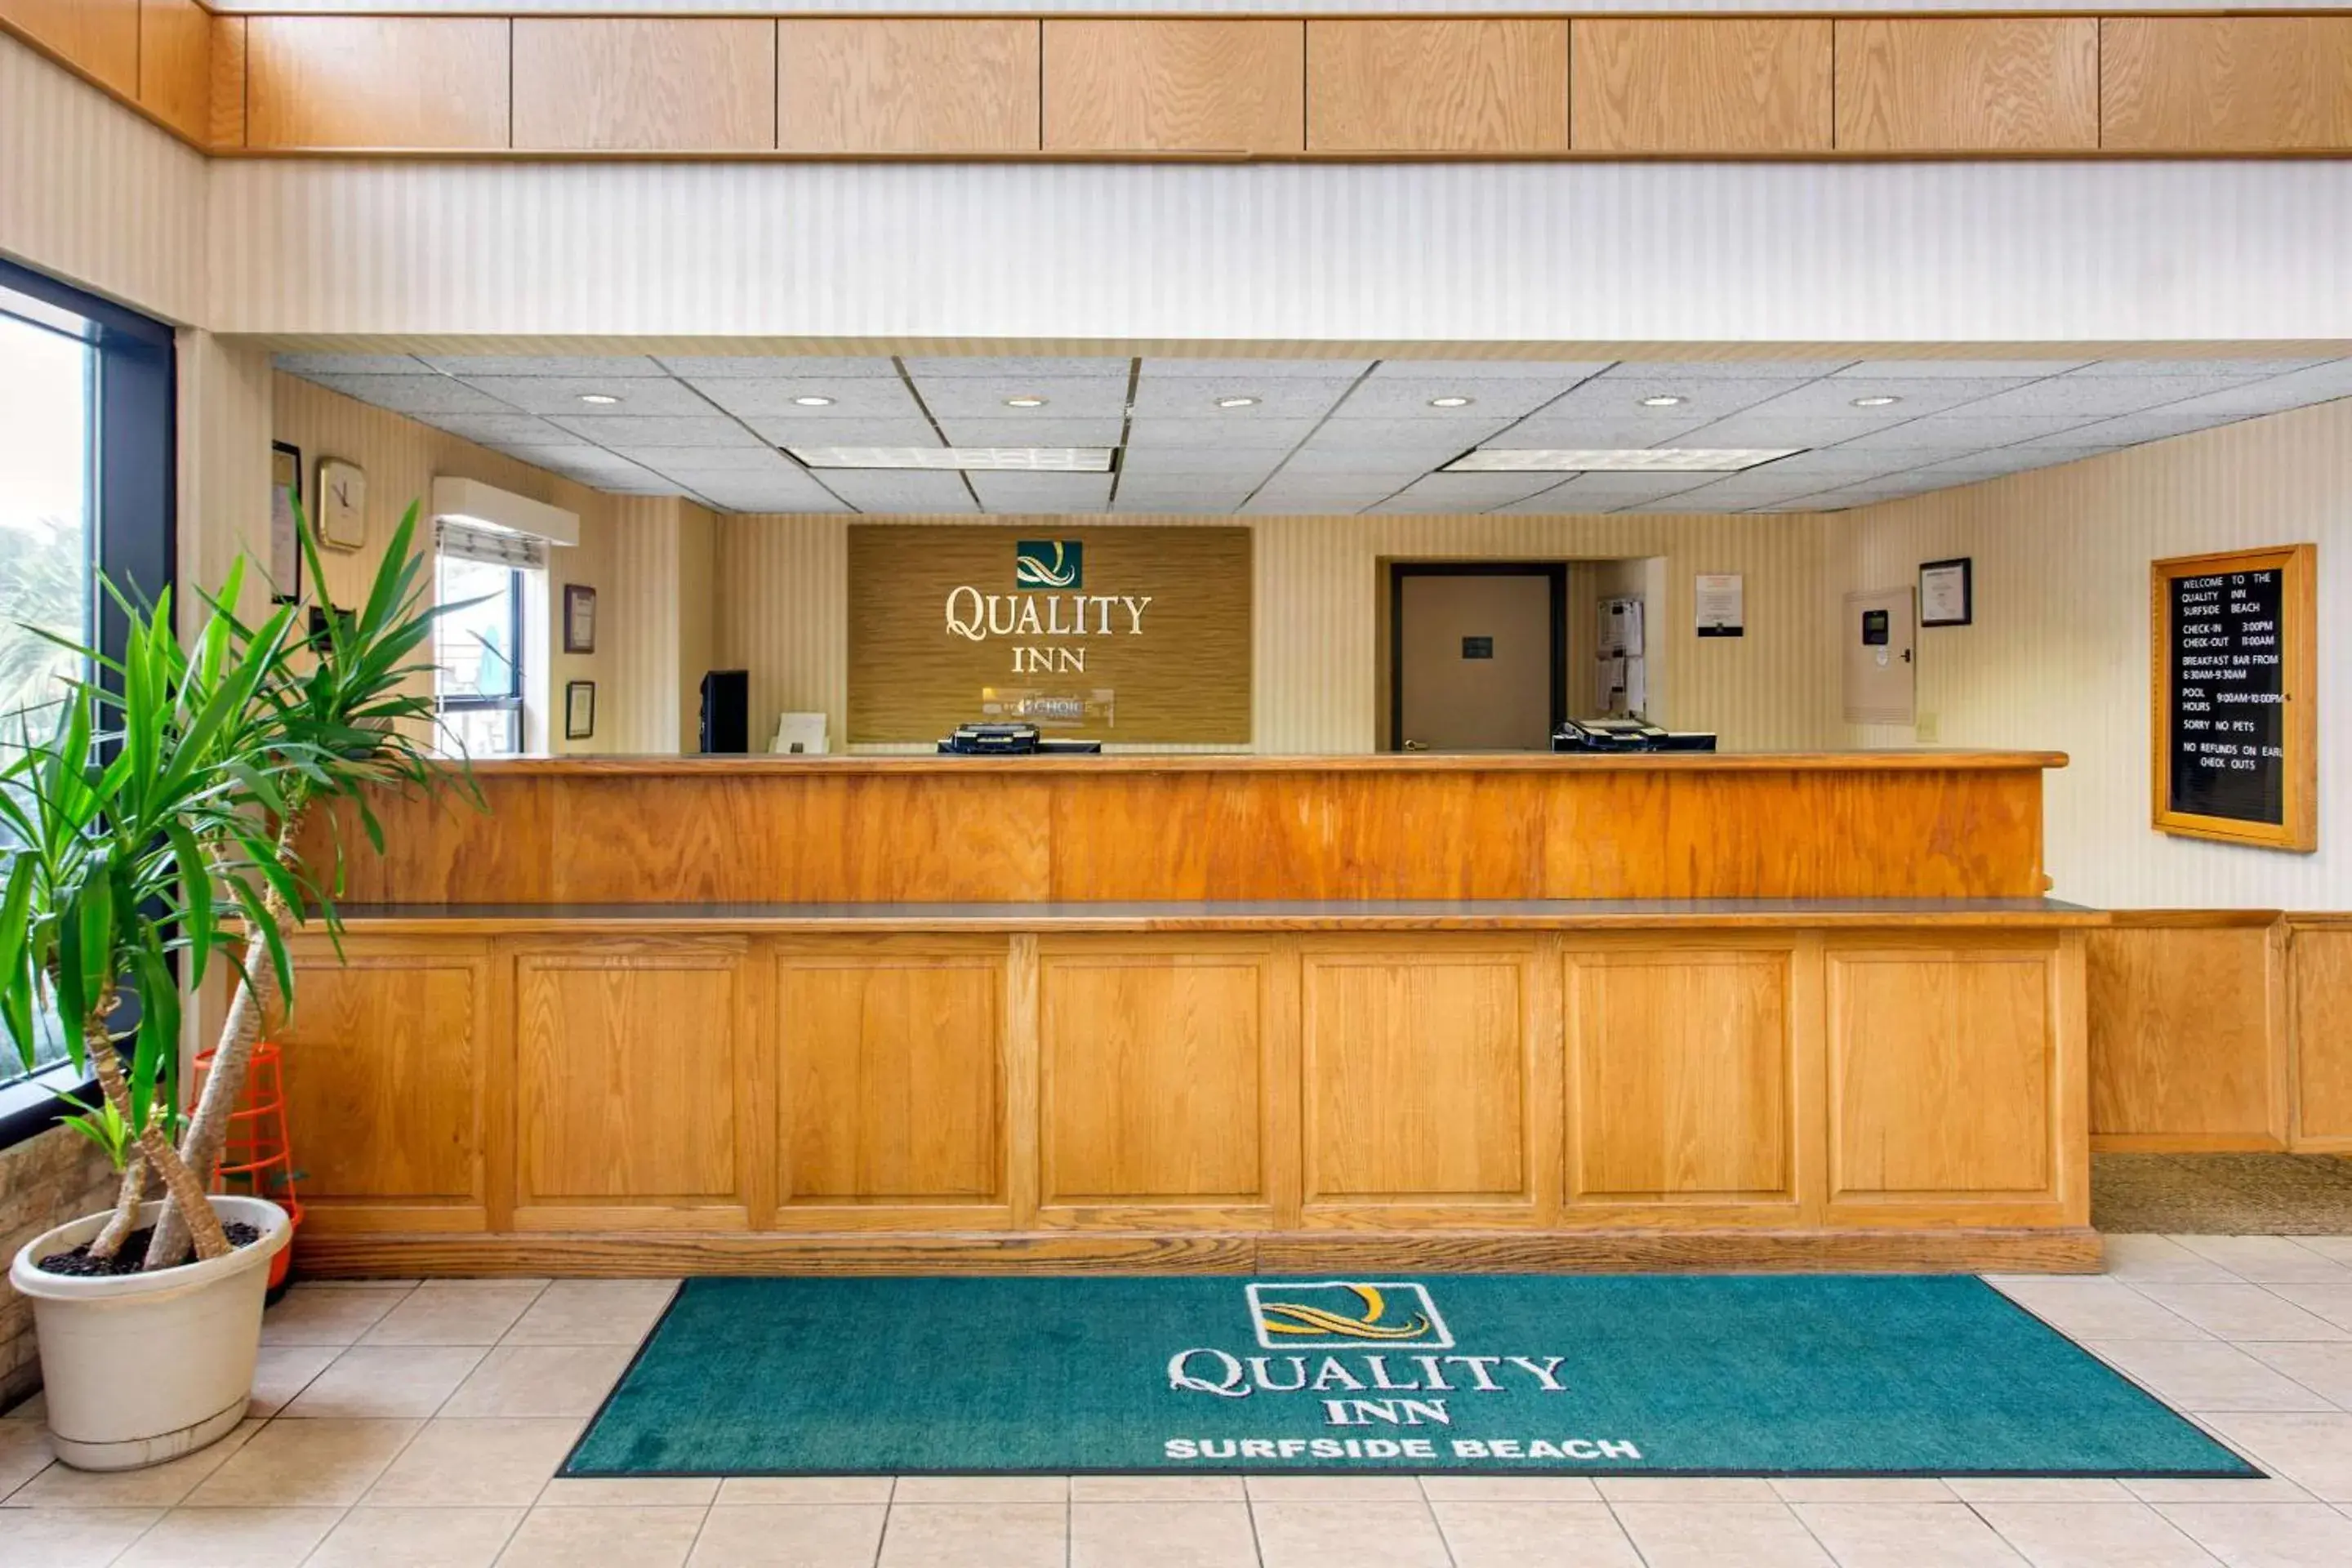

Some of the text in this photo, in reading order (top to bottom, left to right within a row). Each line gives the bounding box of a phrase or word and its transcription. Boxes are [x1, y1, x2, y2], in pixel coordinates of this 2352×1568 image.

[2184, 572, 2271, 589] WELCOME TO THE
[2182, 590, 2246, 603] QUALITY INN
[946, 586, 1152, 641] QUALITY
[2184, 603, 2260, 616] SURFSIDE BEACH
[2183, 621, 2273, 634] CHECK-IN 3:00PM
[2183, 636, 2274, 648] CHECK-OUT 11:00AM
[1012, 647, 1085, 673] INN
[2182, 655, 2278, 666] BREAKFAST BAR FROM
[2182, 688, 2205, 697] POOL
[2182, 702, 2210, 711] HOURS
[2184, 719, 2254, 732] SORRY NO PETS
[2184, 742, 2283, 757] NO REFUNDS ON EARL
[2201, 757, 2256, 770] CHECK OUTS
[1166, 1348, 1570, 1397] QUALITY
[1324, 1398, 1452, 1426] INN
[1165, 1438, 1643, 1459] SURFSIDE BEACH
